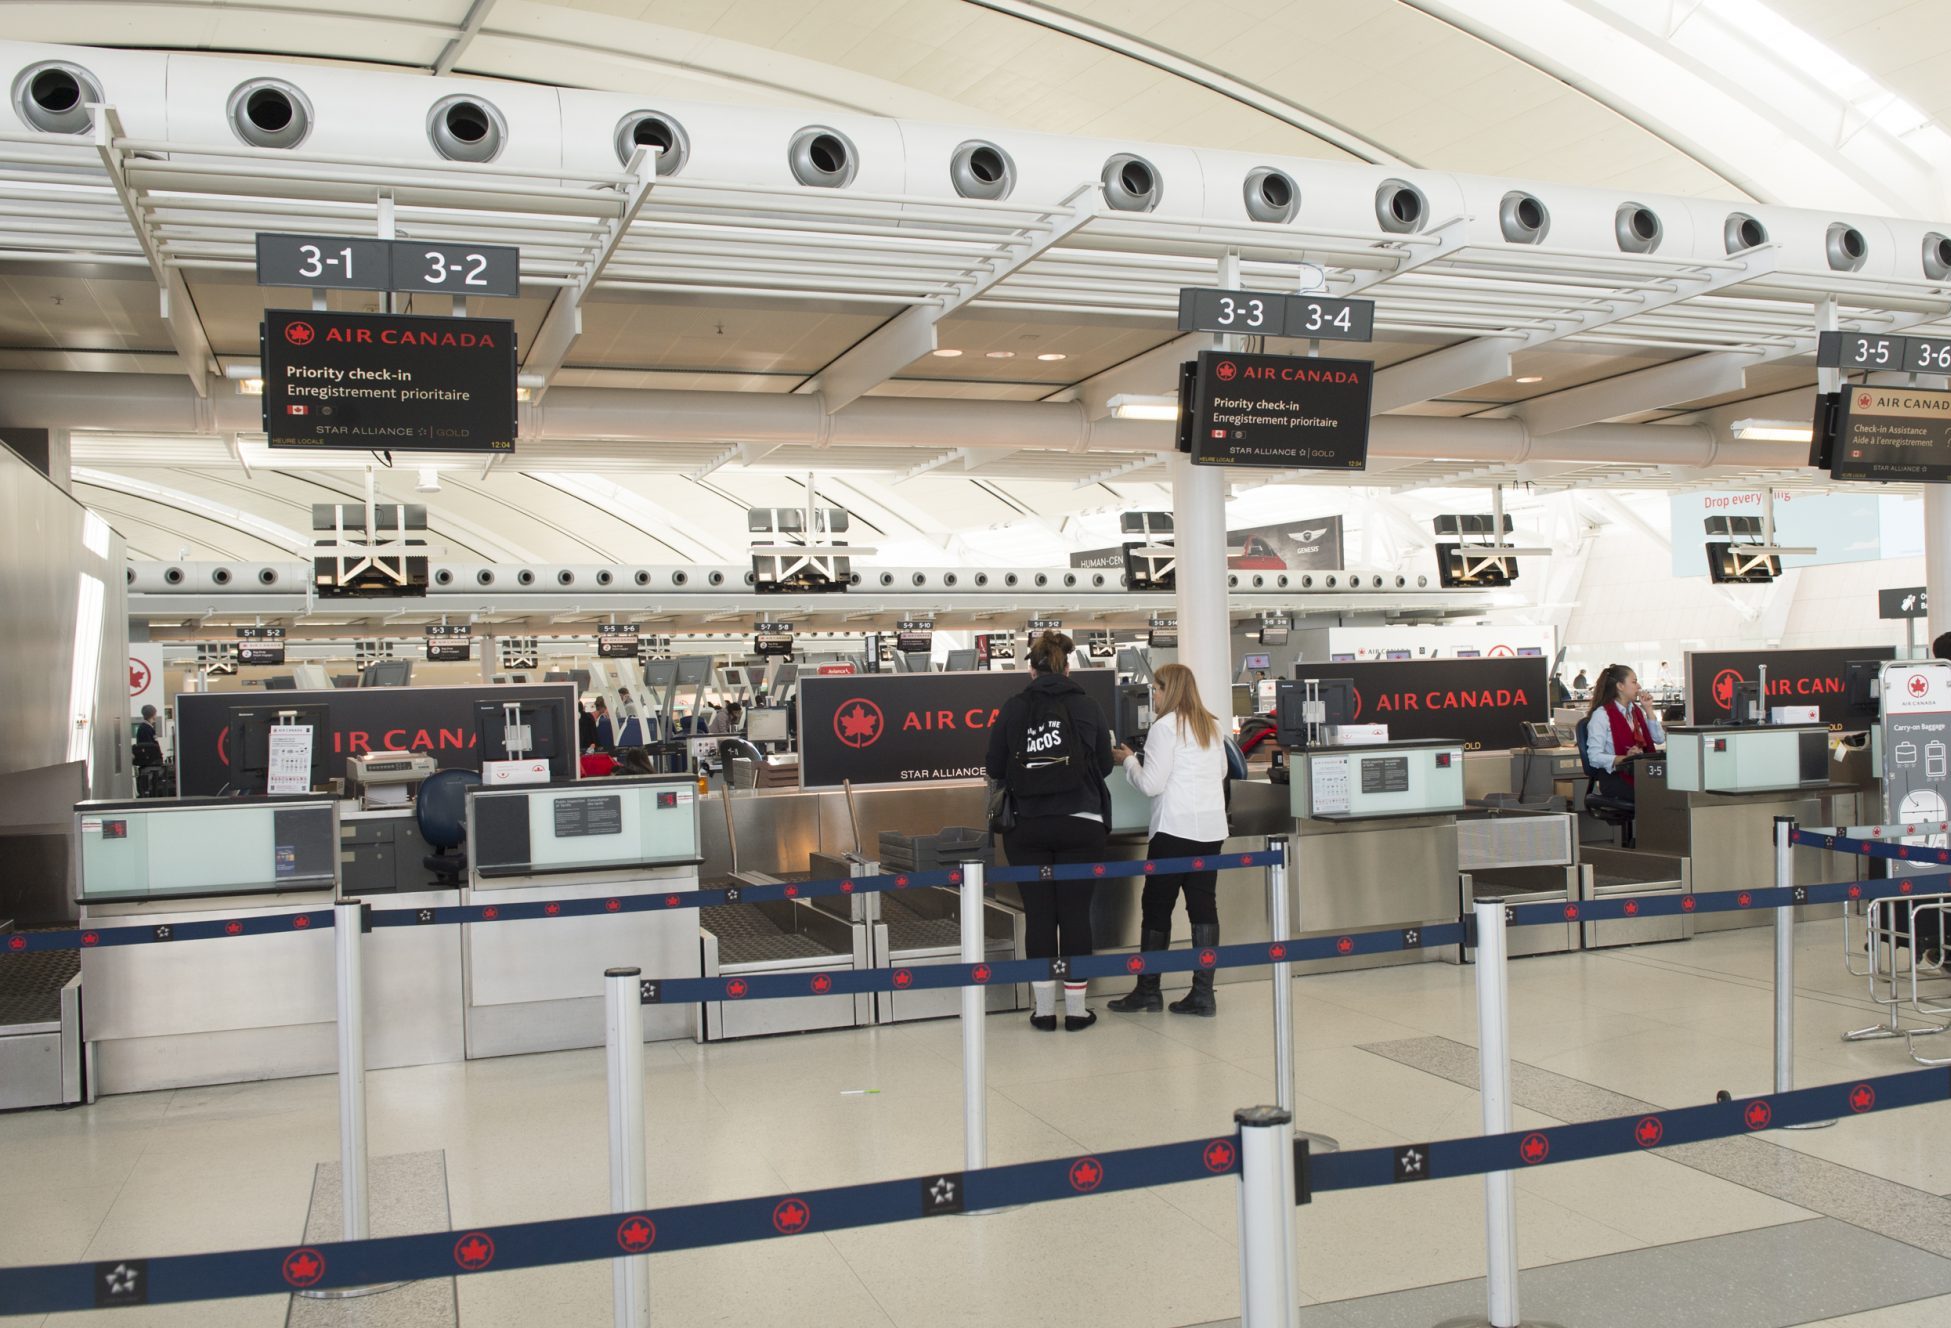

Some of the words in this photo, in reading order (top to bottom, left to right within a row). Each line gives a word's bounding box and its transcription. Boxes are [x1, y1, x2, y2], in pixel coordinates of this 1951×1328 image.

[299, 245, 352, 278] 3-1
[424, 252, 488, 286] 3-2
[1217, 298, 1264, 327] 3-3
[1305, 304, 1352, 332] 3-4
[326, 327, 373, 344] AIR
[380, 329, 495, 348] CANADA
[1855, 339, 1890, 363] 3-5
[1918, 344, 1951, 368] 3-6
[287, 366, 344, 382] Priority
[348, 367, 412, 381] check-in
[1243, 366, 1276, 380] AIR
[1281, 368, 1359, 384] CANADA
[287, 384, 396, 400] Enregistrement
[401, 389, 470, 402] prioritaire
[1214, 397, 1254, 411] Priority
[1256, 399, 1300, 411] check-in
[1877, 397, 1900, 408] AIR
[1213, 412, 1287, 426] Enregistrement
[1289, 416, 1338, 428] prioritaire
[316, 425, 349, 434] STAR
[352, 427, 414, 436] ALLIANCE
[436, 428, 470, 437] GOLD
[1854, 424, 1887, 434] Check-in
[1888, 425, 1928, 435] Assistance
[491, 441, 511, 449] 12:04
[1852, 436, 1869, 444] Aide
[1229, 446, 1252, 455] STAR
[1255, 447, 1296, 456] ALLIANCE
[1704, 497, 1729, 509] Drop
[432, 626, 445, 634] 5-3
[453, 626, 466, 634] 5-4
[1796, 677, 1846, 695] CAN
[1376, 692, 1420, 712] AIR
[1425, 689, 1528, 710] CANADA
[902, 710, 956, 732] AIR
[1048, 720, 1061, 729] THE
[1828, 723, 1843, 731] OLD
[1893, 723, 1920, 733] Carry-on
[334, 731, 373, 752] IR
[1464, 741, 1481, 750] OLD
[900, 769, 930, 779] STAR
[932, 766, 987, 778] ALLIANCE
[1648, 765, 1663, 776] 3-5
